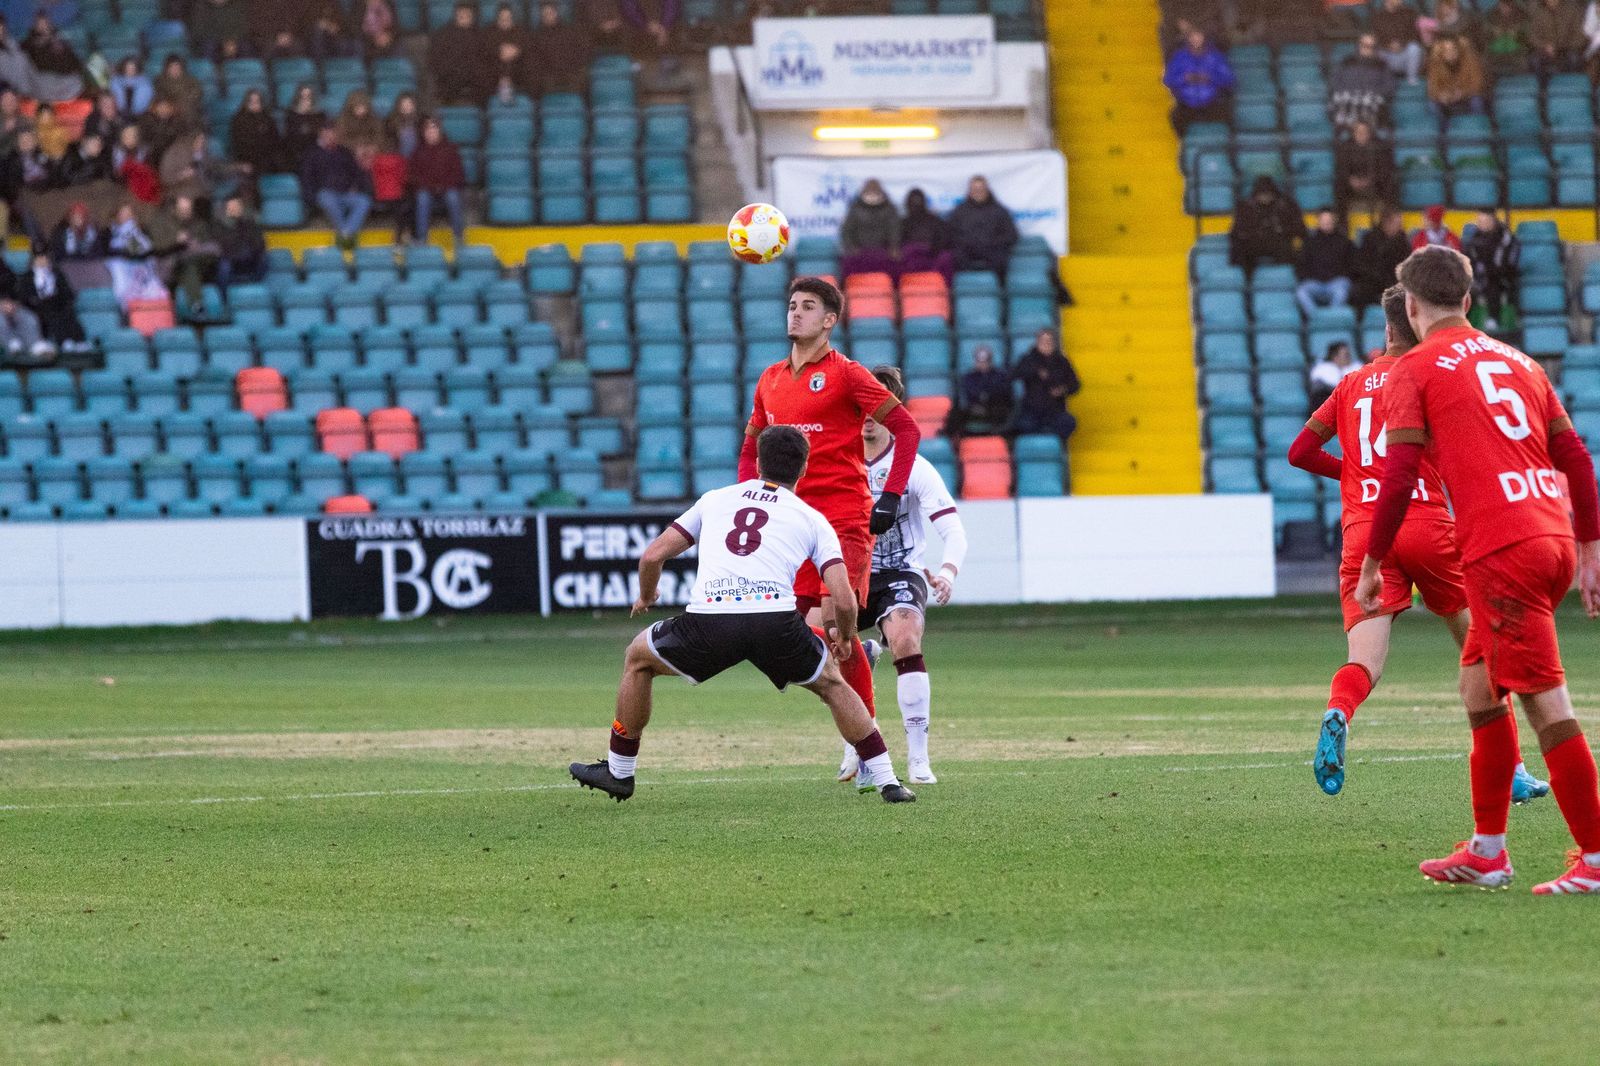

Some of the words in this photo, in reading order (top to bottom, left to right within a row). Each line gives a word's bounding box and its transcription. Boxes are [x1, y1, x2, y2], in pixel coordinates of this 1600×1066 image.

[833, 38, 987, 60] MINIMARKET
[1475, 361, 1532, 441] 5
[741, 489, 779, 504] ALBA
[1360, 477, 1430, 503] DI
[318, 518, 415, 541] CUADRA
[724, 507, 770, 556] 8
[704, 575, 734, 590] nani
[704, 586, 781, 598] EMPRESARIAL
